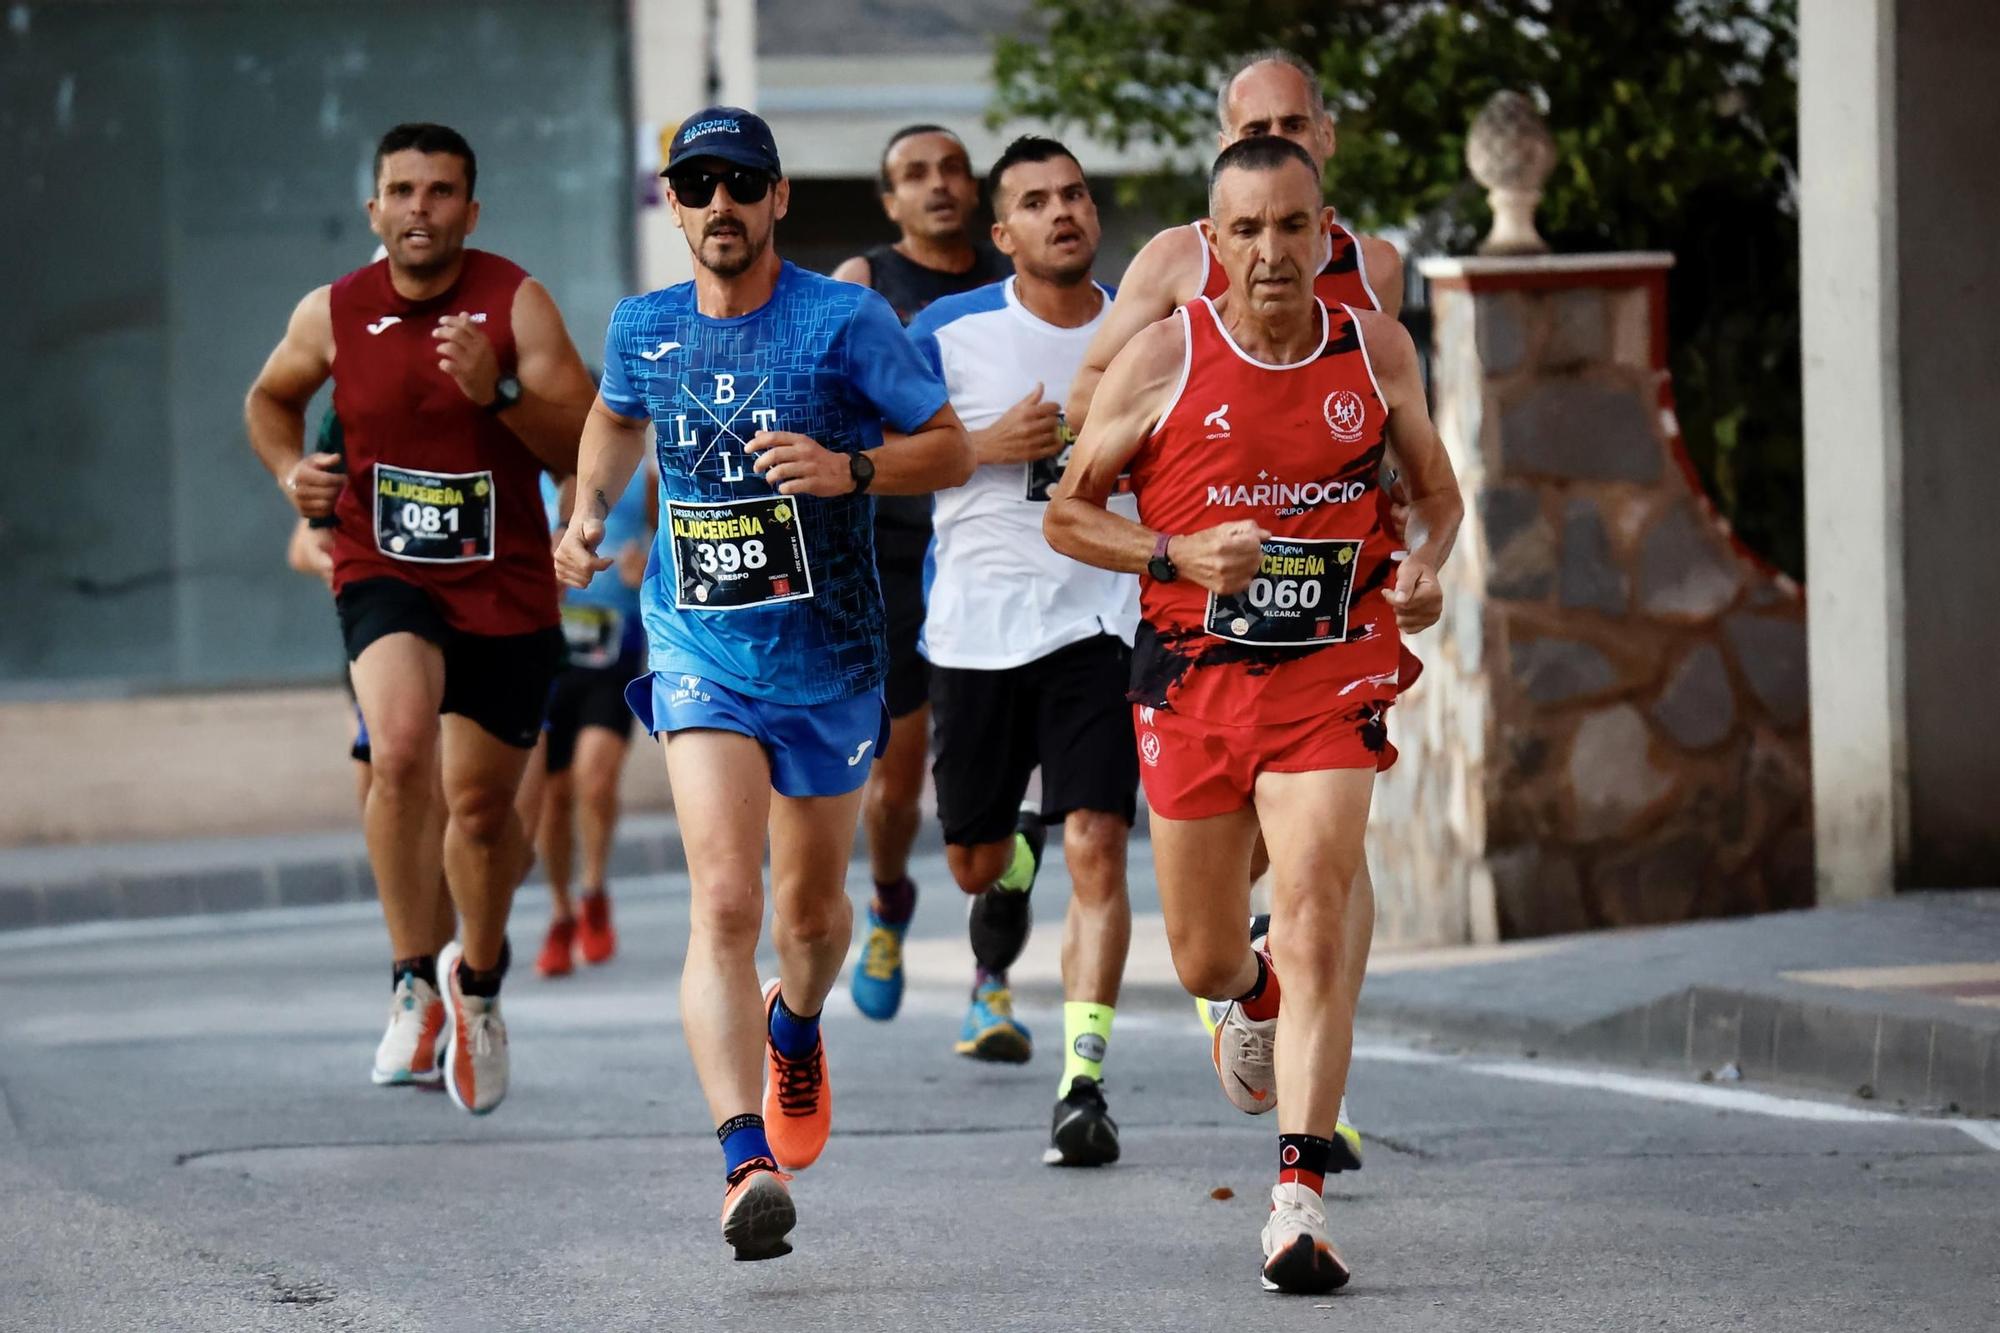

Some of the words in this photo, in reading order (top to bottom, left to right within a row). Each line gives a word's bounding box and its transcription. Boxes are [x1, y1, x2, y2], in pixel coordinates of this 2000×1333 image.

[713, 373, 735, 404] B
[676, 415, 698, 446] L
[719, 451, 744, 482] L
[379, 479, 465, 505] ALJUCEREÑA
[1206, 479, 1366, 507] MARINOCIO
[402, 502, 459, 532] 081
[695, 508, 734, 520] NOCTURNA
[1275, 507, 1304, 516] GRUPO
[674, 515, 765, 540] ALJUCEREÑA
[697, 539, 768, 573] 398
[1260, 543, 1304, 555] NOCTURNA
[717, 572, 750, 581] KRESPO
[1260, 554, 1326, 576] CEREÑA
[1248, 578, 1322, 609] 060
[1263, 609, 1301, 618] ALCARAZ
